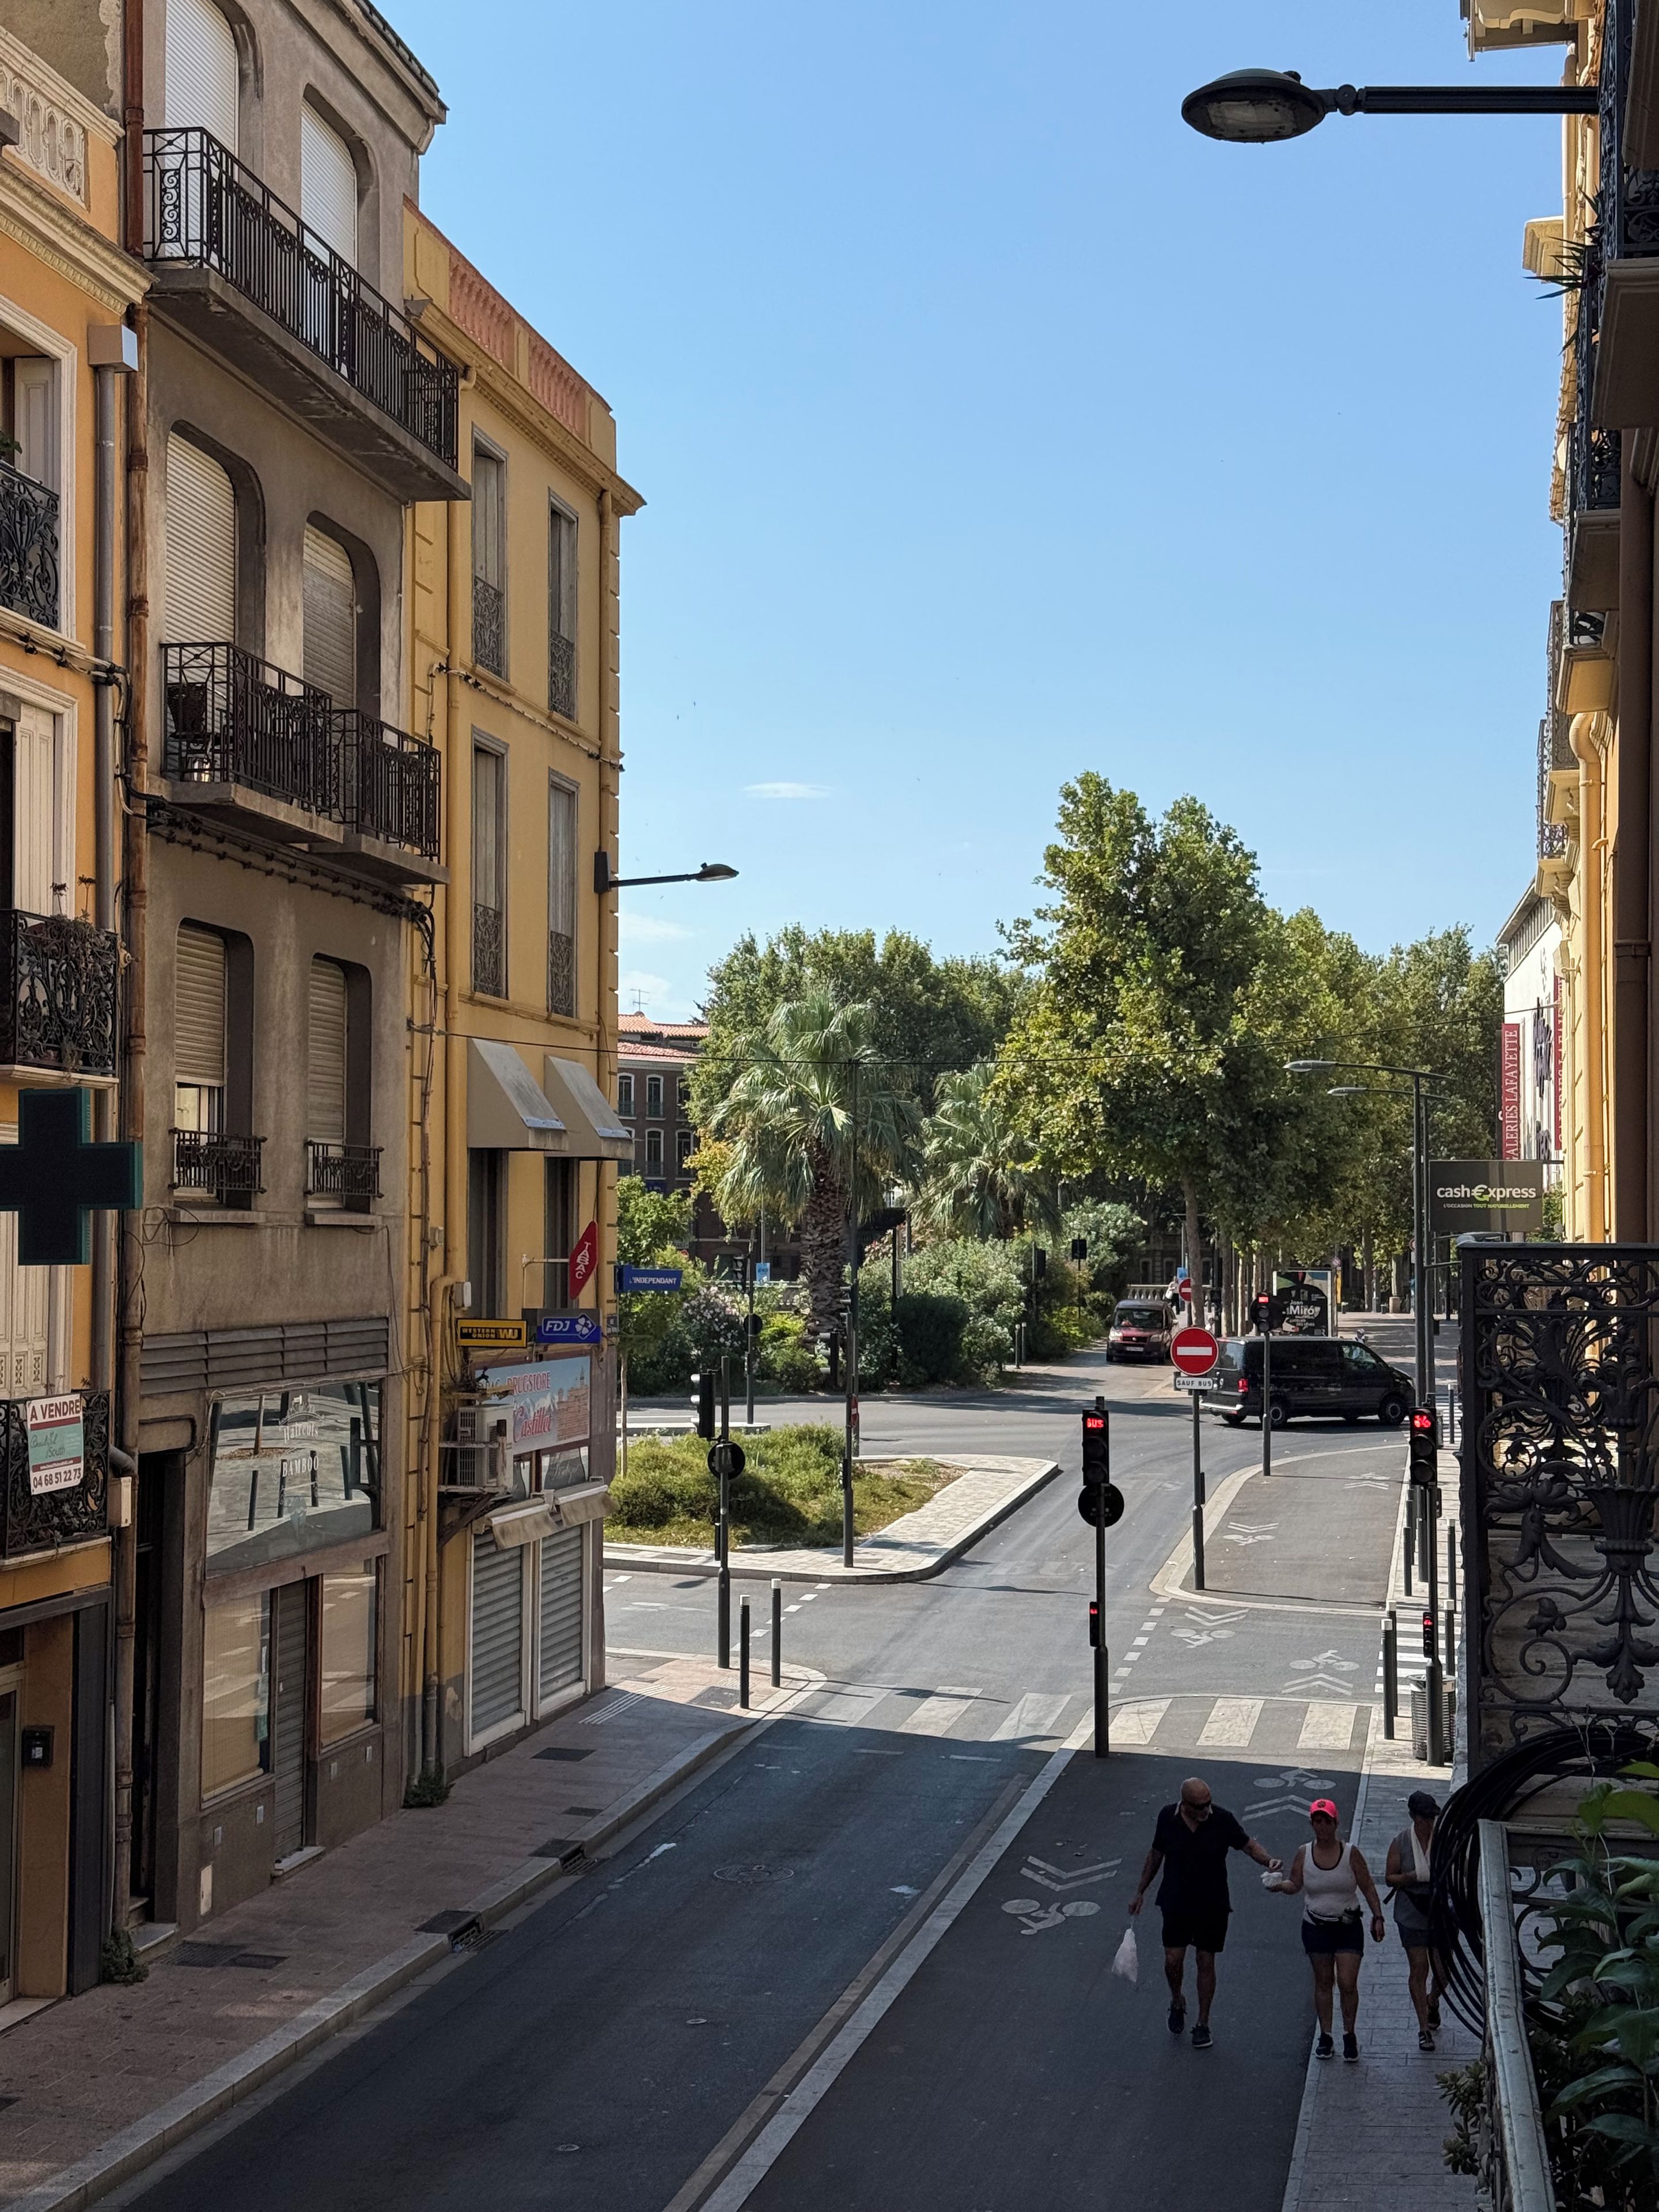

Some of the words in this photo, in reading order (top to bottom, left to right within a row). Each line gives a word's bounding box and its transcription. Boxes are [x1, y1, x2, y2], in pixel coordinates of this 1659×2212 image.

[1505, 1030, 1518, 1101] LAFAYETTE
[1505, 1105, 1519, 1160] ALERIES
[575, 1241, 591, 1279] TABAC
[1290, 1305, 1314, 1315] Miró
[499, 1328, 518, 1339] WU
[546, 1320, 570, 1332] FDJ
[30, 1405, 38, 1422] A
[40, 1399, 81, 1420] VENDRE
[284, 1421, 318, 1443] Haircuts
[1087, 1418, 1104, 1427] BUS
[282, 1456, 319, 1477] BAMBOO
[33, 1475, 43, 1488] 04
[44, 1474, 53, 1487] 68
[55, 1471, 62, 1484] 51
[63, 1469, 72, 1482] 22
[73, 1467, 81, 1480] 73
